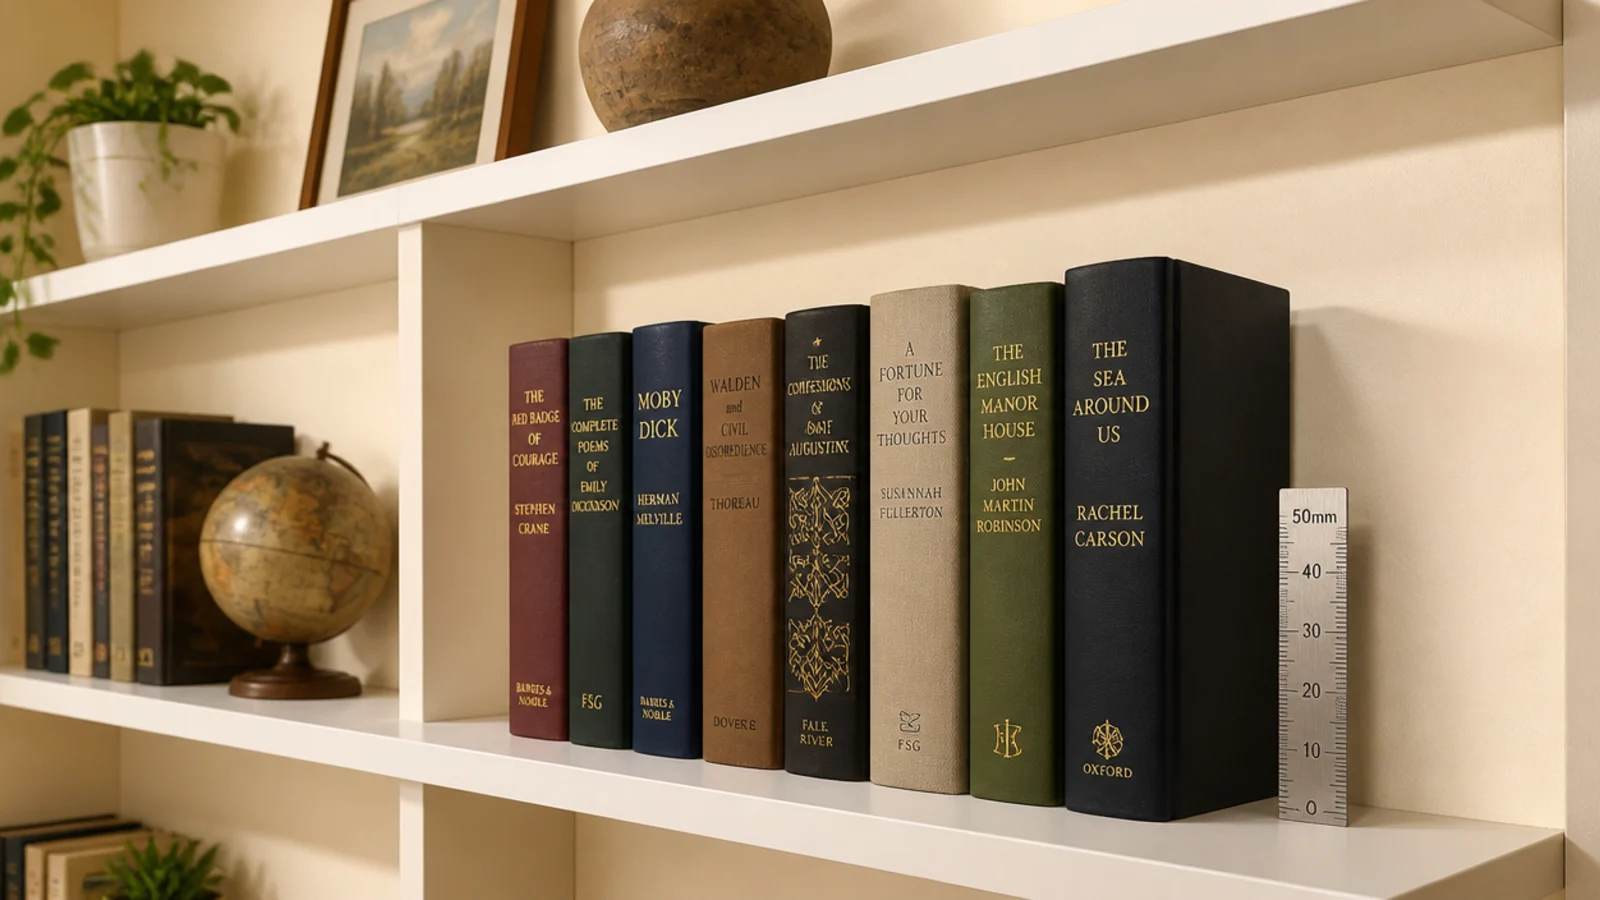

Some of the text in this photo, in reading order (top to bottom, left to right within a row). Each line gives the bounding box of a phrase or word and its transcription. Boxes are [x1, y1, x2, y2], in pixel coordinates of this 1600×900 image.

[905, 340, 915, 357] A
[992, 343, 1024, 361] THE
[1092, 339, 1128, 359] THE
[879, 361, 944, 382] FORTUNE
[976, 368, 1042, 389] ENGLISH
[1093, 369, 1127, 388] SEA
[710, 374, 761, 394] WALDEN
[524, 389, 545, 404] THE
[637, 389, 682, 411] MOBY
[897, 386, 923, 403] FOR
[583, 396, 604, 411] THE
[980, 394, 1039, 415] MANOR
[1072, 395, 1150, 416] AROUND
[529, 409, 560, 425] BADGE
[892, 408, 929, 425] YOUR
[571, 418, 618, 433] COMPLETE
[638, 418, 679, 440] DICK
[721, 422, 749, 437] CIVIL
[983, 421, 1035, 440] HOUSE
[527, 432, 542, 446] OF
[876, 429, 947, 447] THOUGHTS
[1097, 425, 1121, 444] US
[577, 439, 609, 454] POEMS
[512, 451, 559, 468] COURAGE
[586, 460, 600, 473] OF
[990, 477, 1026, 492] JOHN
[709, 496, 760, 511] THOREAU
[983, 498, 1035, 513] MARTIN
[879, 506, 944, 519] FULLERTON
[1077, 504, 1144, 521] RACHEL
[1292, 508, 1337, 525] 50mm
[518, 522, 550, 535] CRANE
[976, 518, 1042, 533] ROBINSON
[1074, 530, 1145, 547] CARSON
[1301, 563, 1322, 579] 40
[1302, 622, 1321, 639] 30
[1302, 682, 1321, 699] 20
[581, 692, 603, 710] FSG
[799, 733, 833, 747] RIVER
[898, 738, 921, 752] FSG
[1303, 741, 1321, 759] 10
[1082, 762, 1134, 779] OXFORD
[1305, 799, 1317, 816] 0
